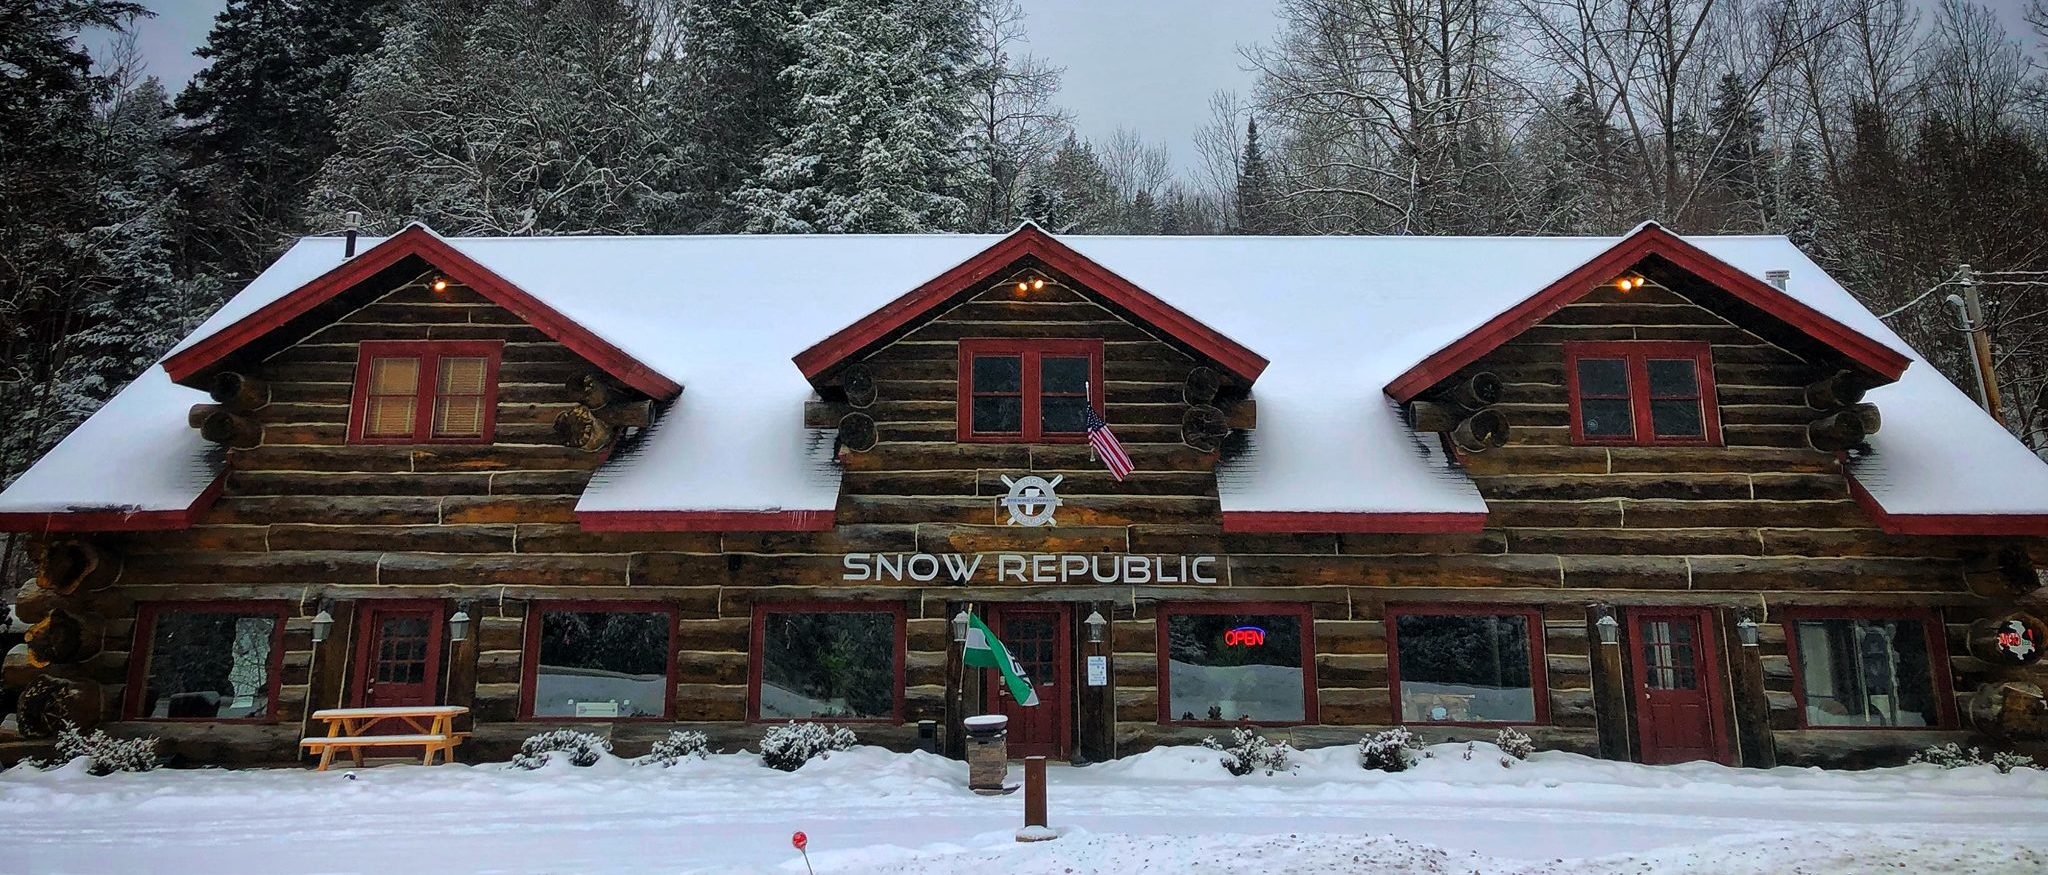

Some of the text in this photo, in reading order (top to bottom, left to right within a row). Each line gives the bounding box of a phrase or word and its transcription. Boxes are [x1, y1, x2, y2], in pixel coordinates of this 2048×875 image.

[843, 553, 1218, 584] SNOW REPUBLIC
[1224, 630, 1264, 646] OPEN
